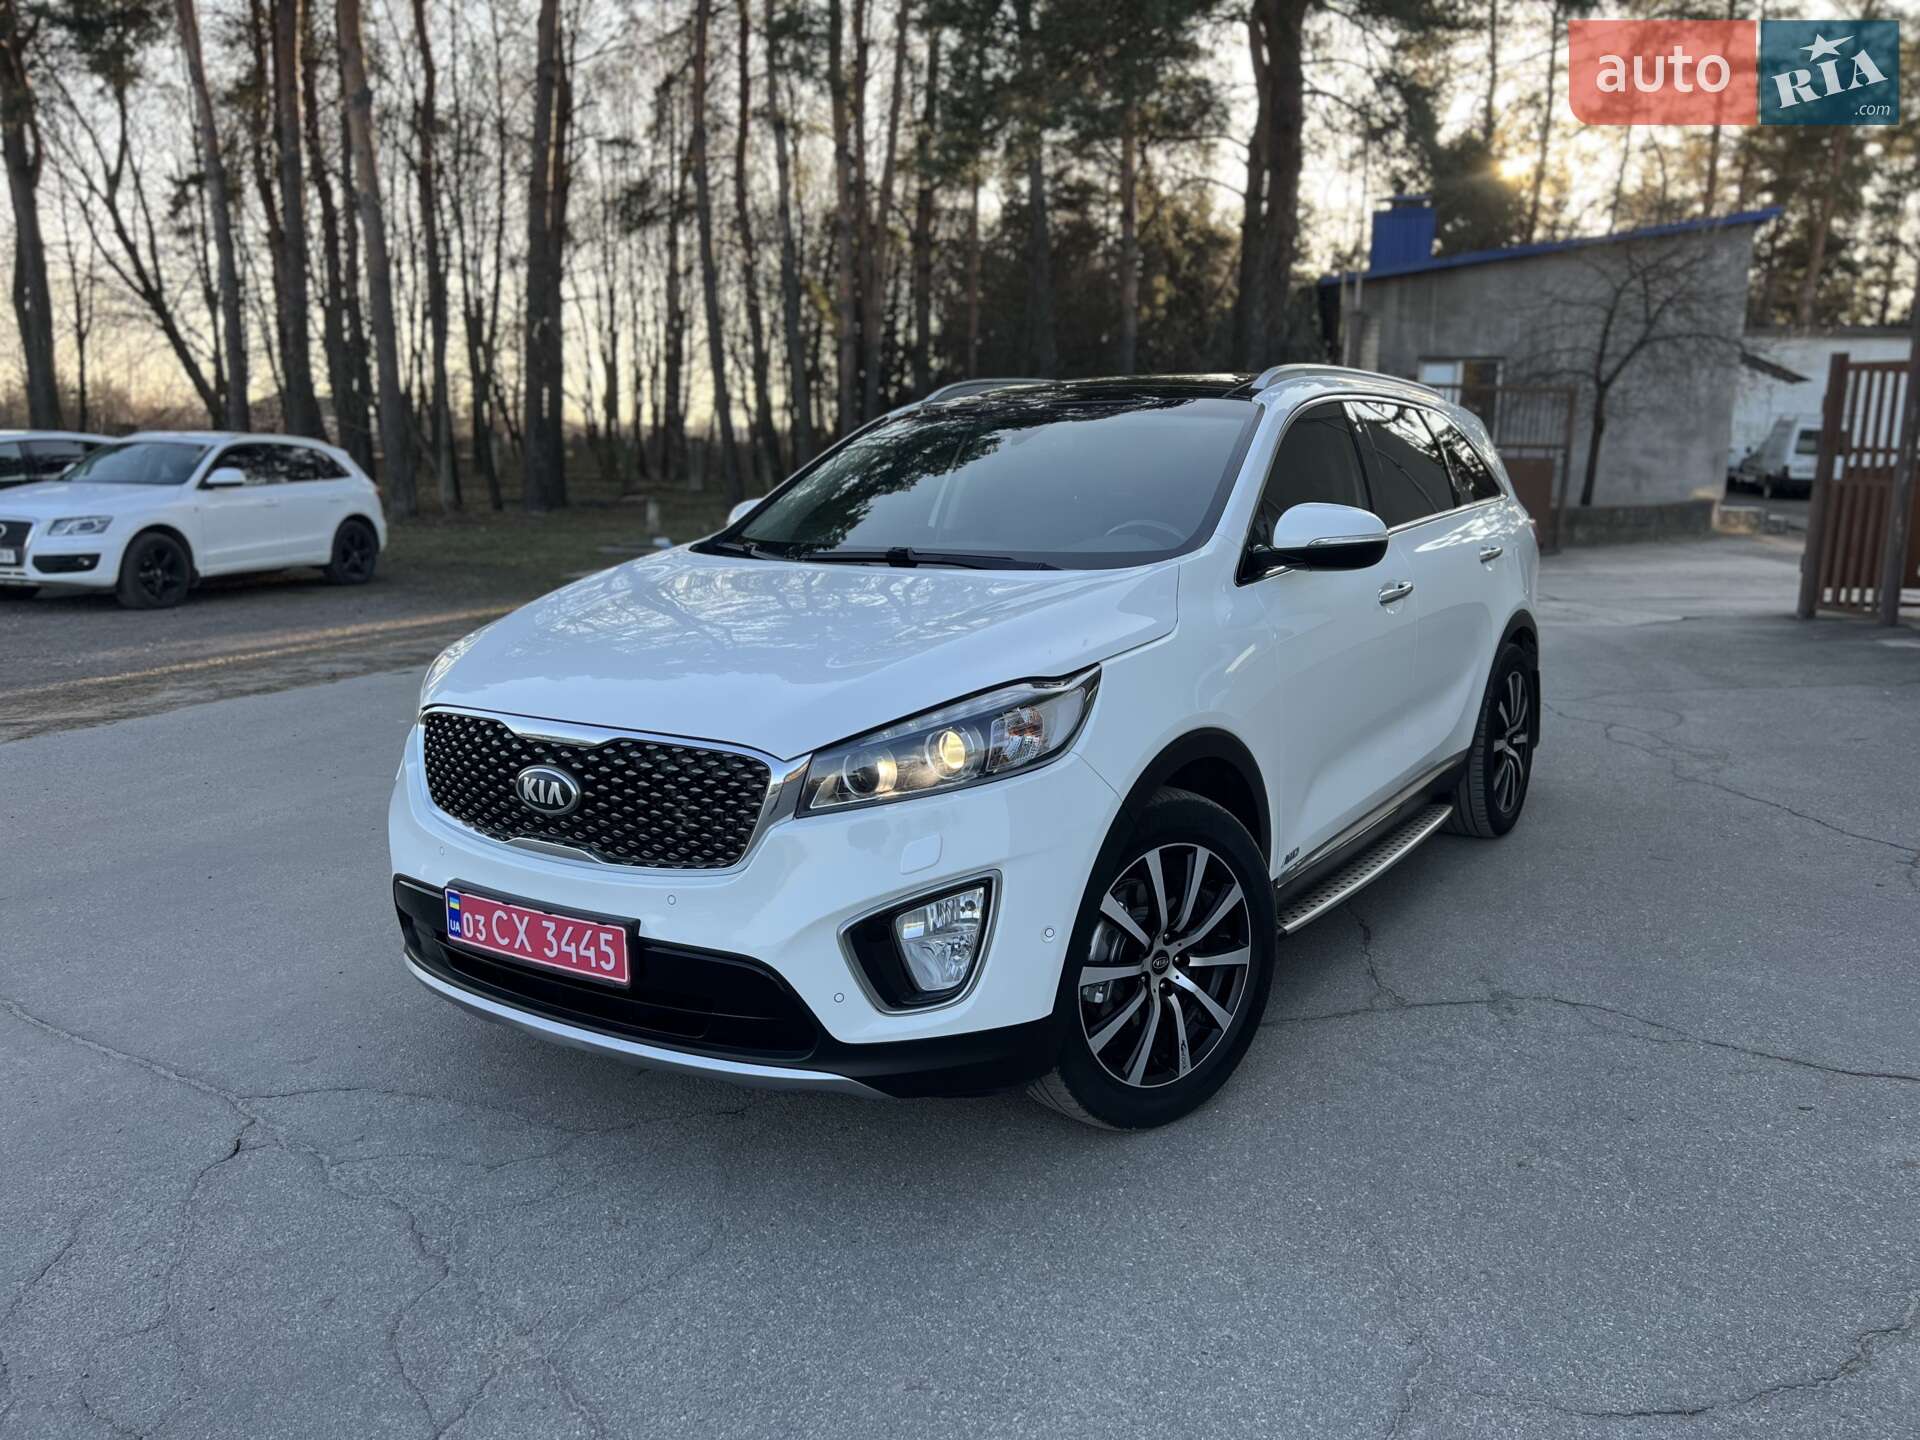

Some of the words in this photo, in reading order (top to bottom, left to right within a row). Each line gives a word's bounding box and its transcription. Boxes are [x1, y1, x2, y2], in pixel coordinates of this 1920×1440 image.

[523, 776, 565, 806] KIA
[450, 919, 461, 933] UA
[463, 912, 487, 942] 03
[492, 910, 532, 952] CX
[541, 920, 616, 971] 3445
